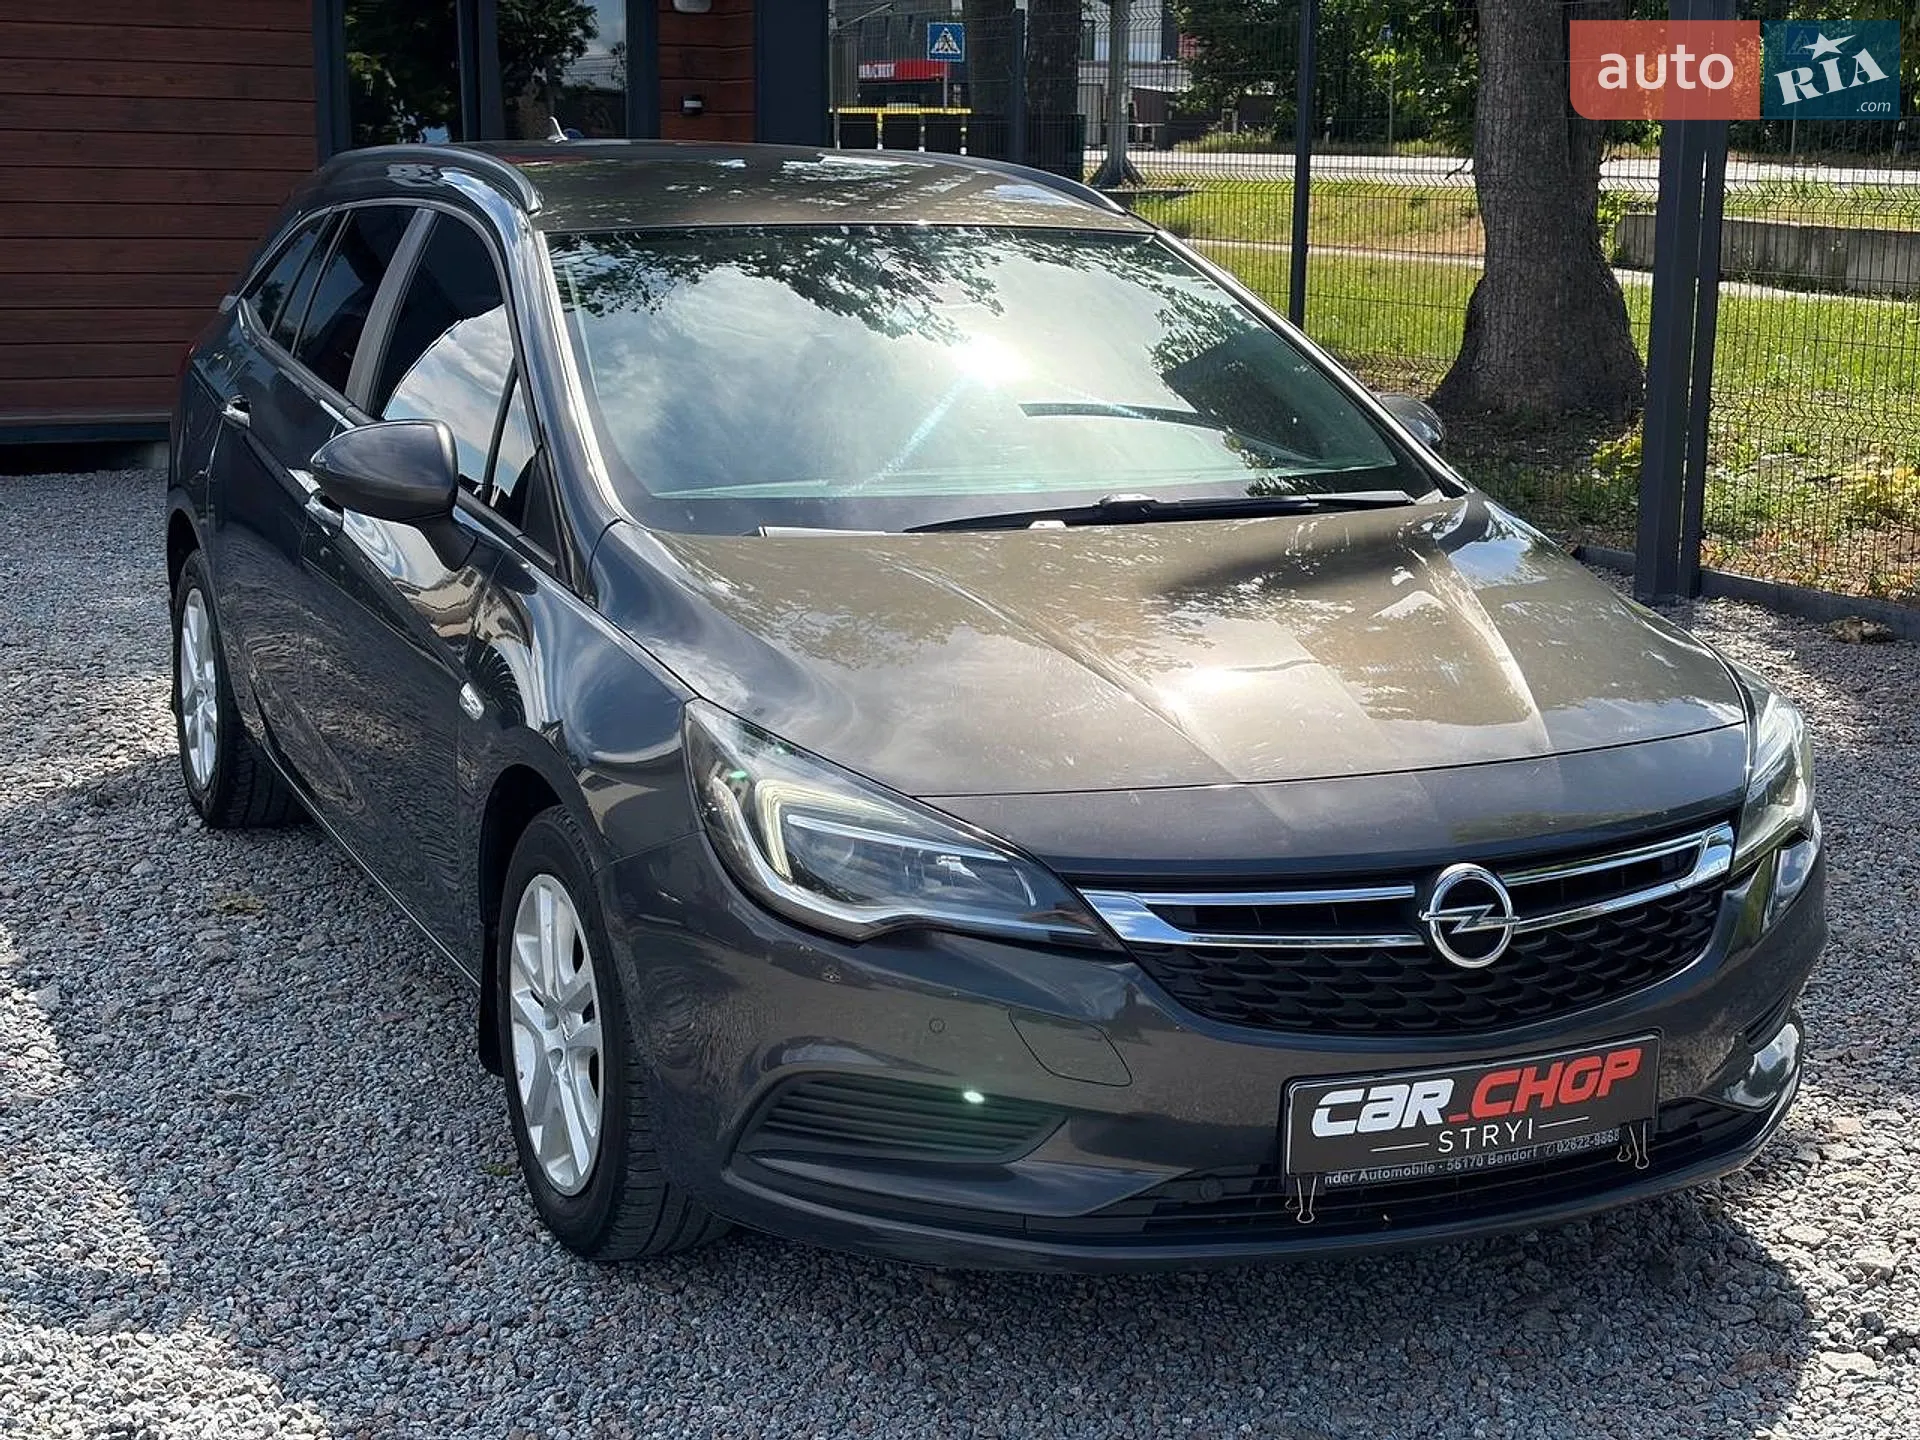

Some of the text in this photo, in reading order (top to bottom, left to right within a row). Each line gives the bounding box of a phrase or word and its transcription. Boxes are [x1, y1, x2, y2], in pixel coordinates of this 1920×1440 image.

[1438, 1118, 1533, 1153] STRYI
[1358, 1161, 1436, 1182] Automobile
[1487, 1145, 1537, 1165] Bendorf
